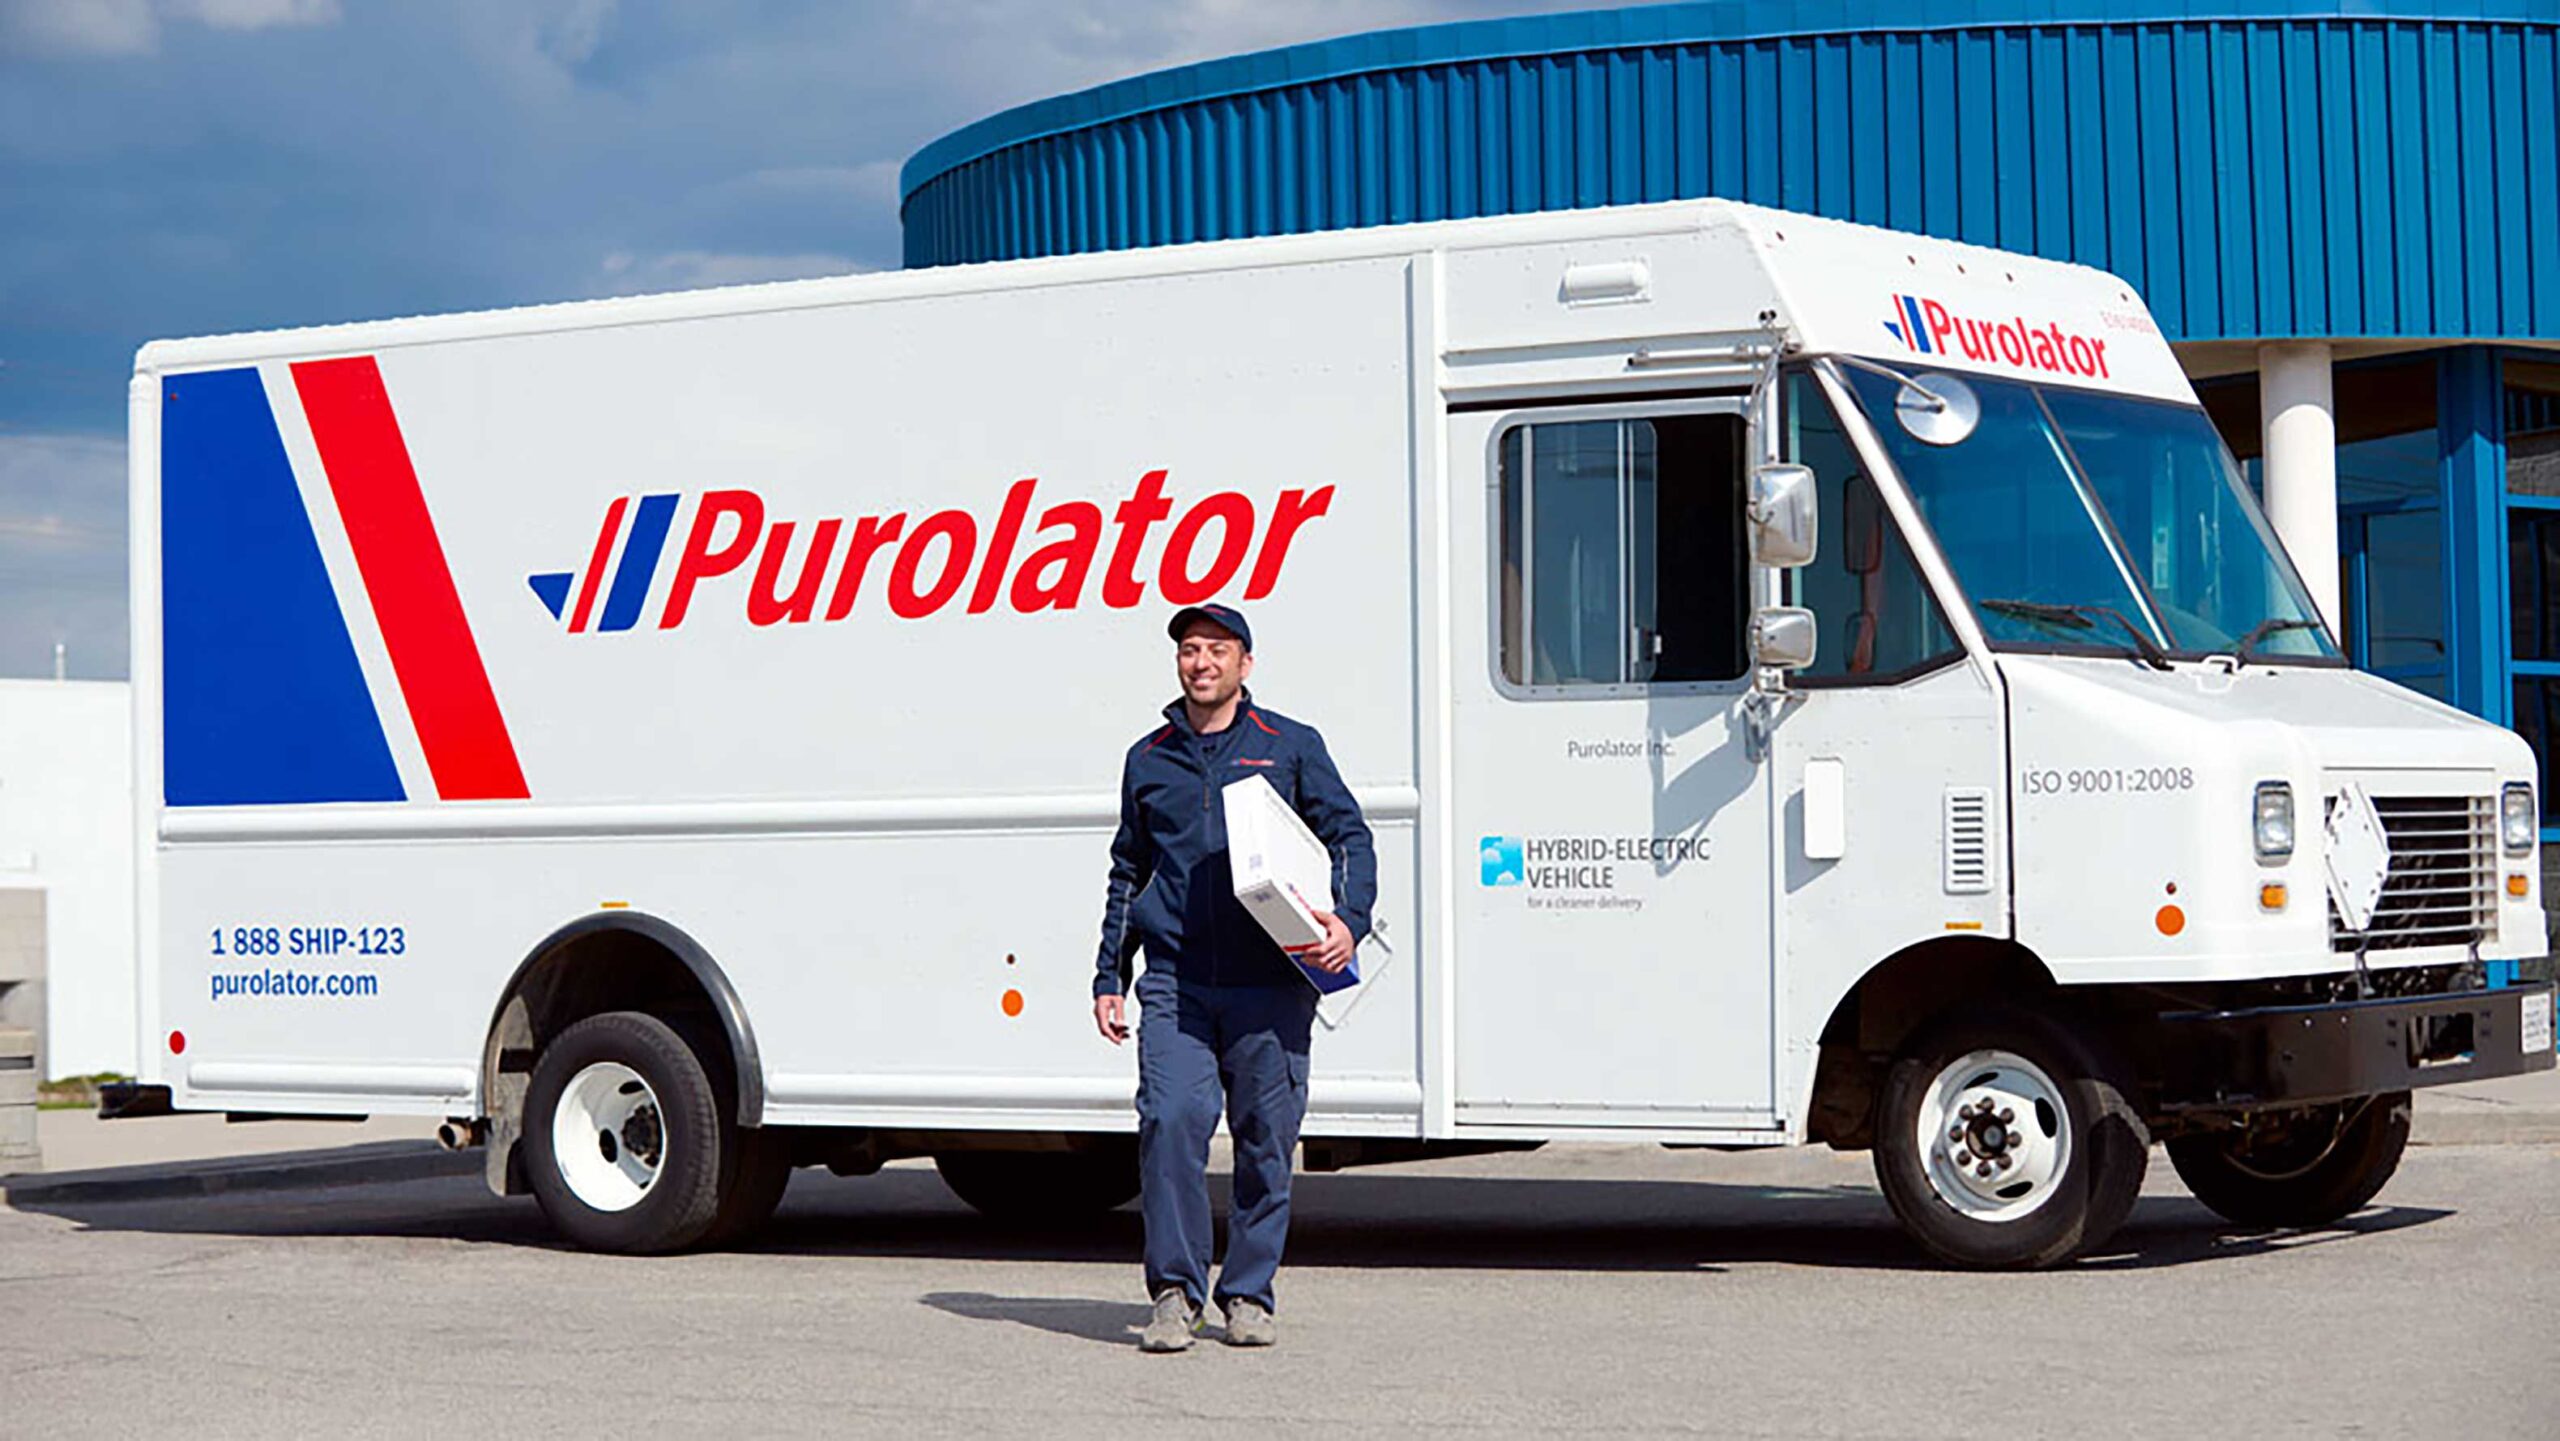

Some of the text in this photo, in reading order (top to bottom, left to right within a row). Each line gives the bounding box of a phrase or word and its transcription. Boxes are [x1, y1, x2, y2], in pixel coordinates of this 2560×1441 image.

[1922, 298, 2110, 379] Purolator
[659, 470, 1334, 629] Purolator
[1568, 740, 1676, 758] Purolator Inc.
[2022, 767, 2194, 794] ISO 9001:2008
[1527, 838, 1711, 862] HYBRID-ELECTRIC
[1527, 866, 1613, 889] VEHICLE
[212, 926, 406, 956] 1 888 SHIP-123
[212, 968, 378, 1000] purolator.com
